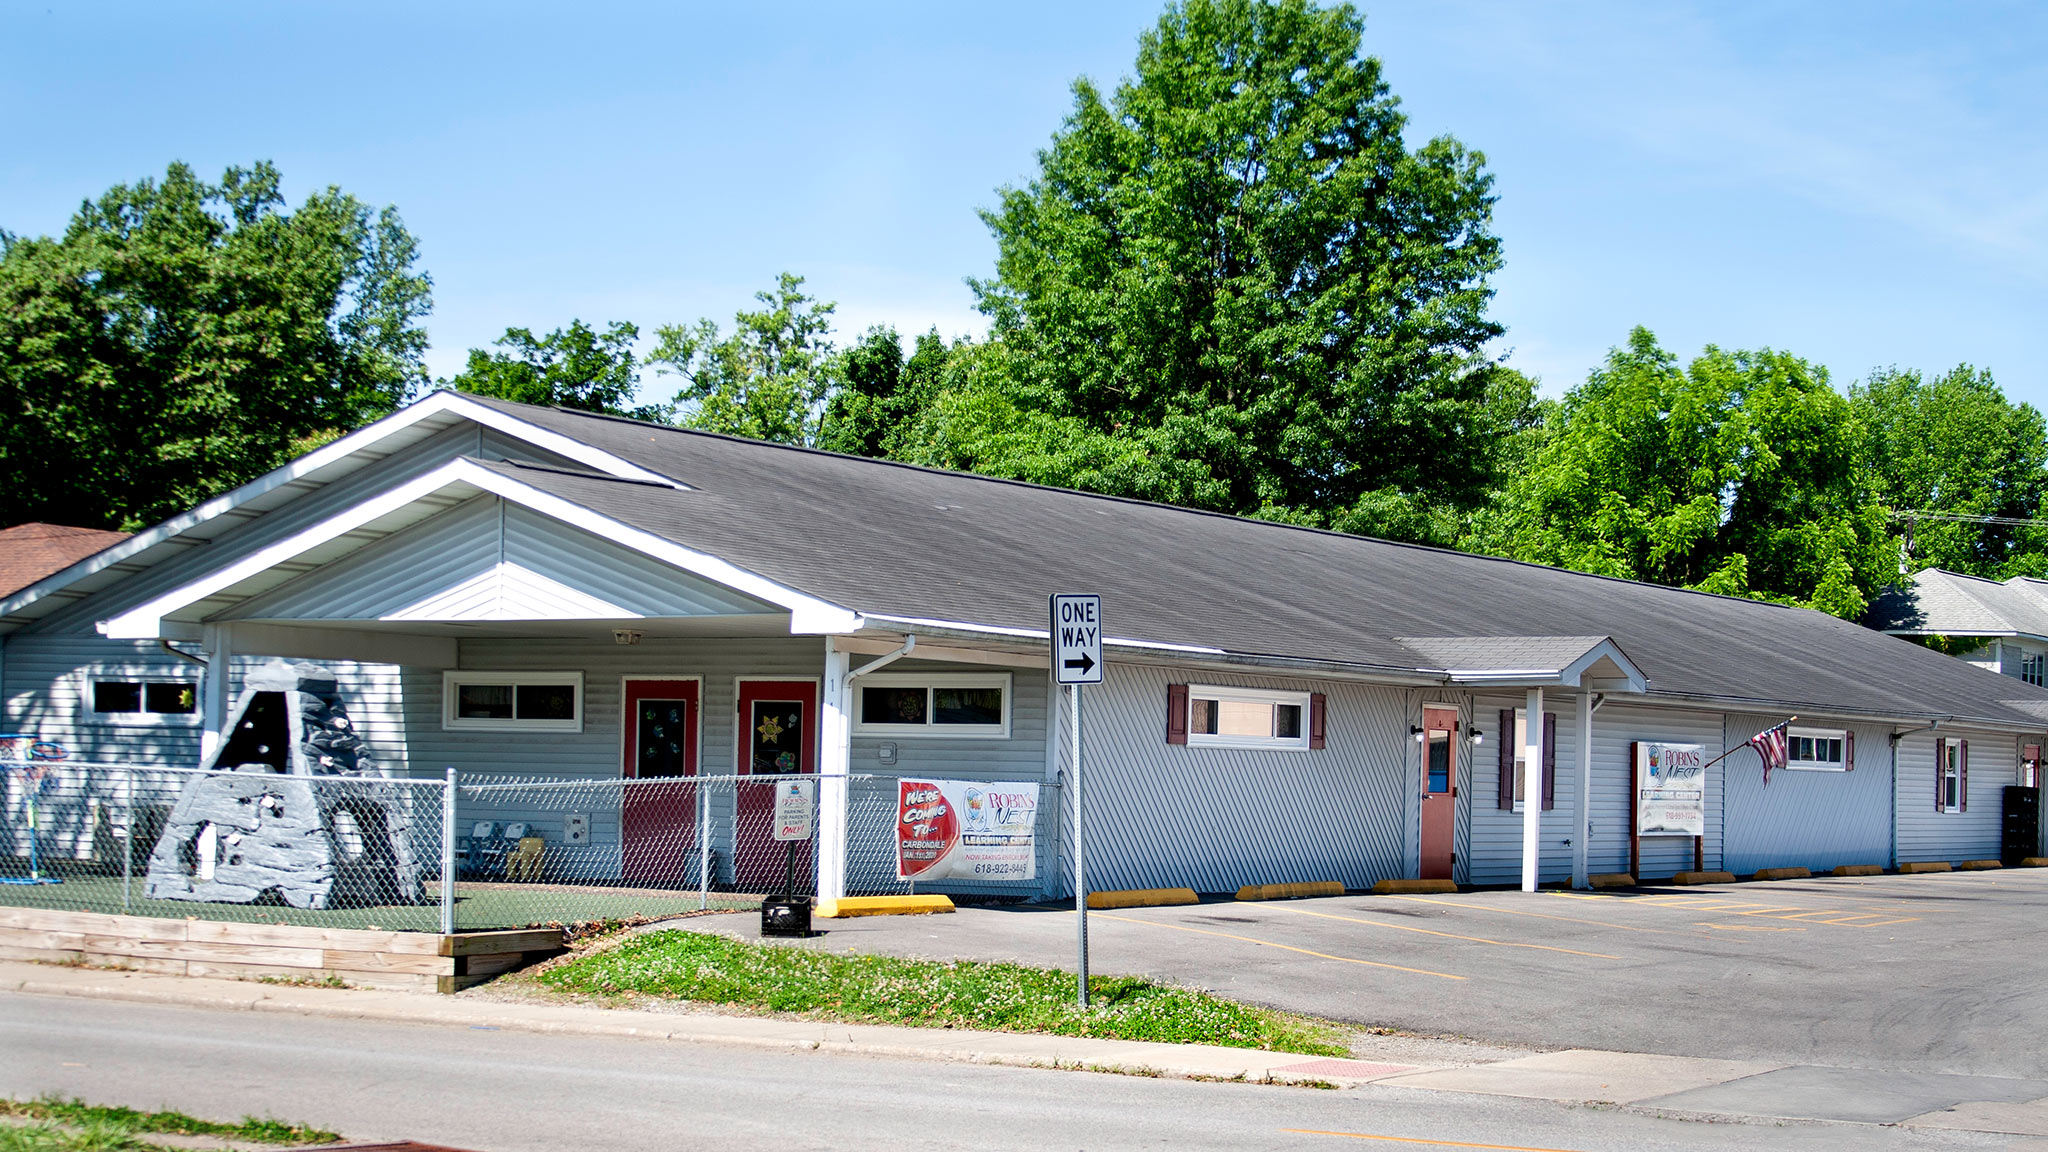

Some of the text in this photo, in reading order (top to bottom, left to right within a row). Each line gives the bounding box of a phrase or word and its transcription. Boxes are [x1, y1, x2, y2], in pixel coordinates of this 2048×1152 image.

[1061, 602, 1096, 623] ONE
[1061, 627, 1097, 647] WAY
[1665, 750, 1700, 767] ROBIN'S
[1664, 765, 1699, 781] NEST
[905, 790, 940, 807] WE'RE
[988, 792, 1035, 808] ROBIN'S
[902, 805, 947, 824] COMING
[994, 807, 1036, 825] NEST
[782, 824, 805, 837] ONLY!
[902, 840, 946, 849] CARBONDALE
[965, 836, 1008, 846] LEARNING
